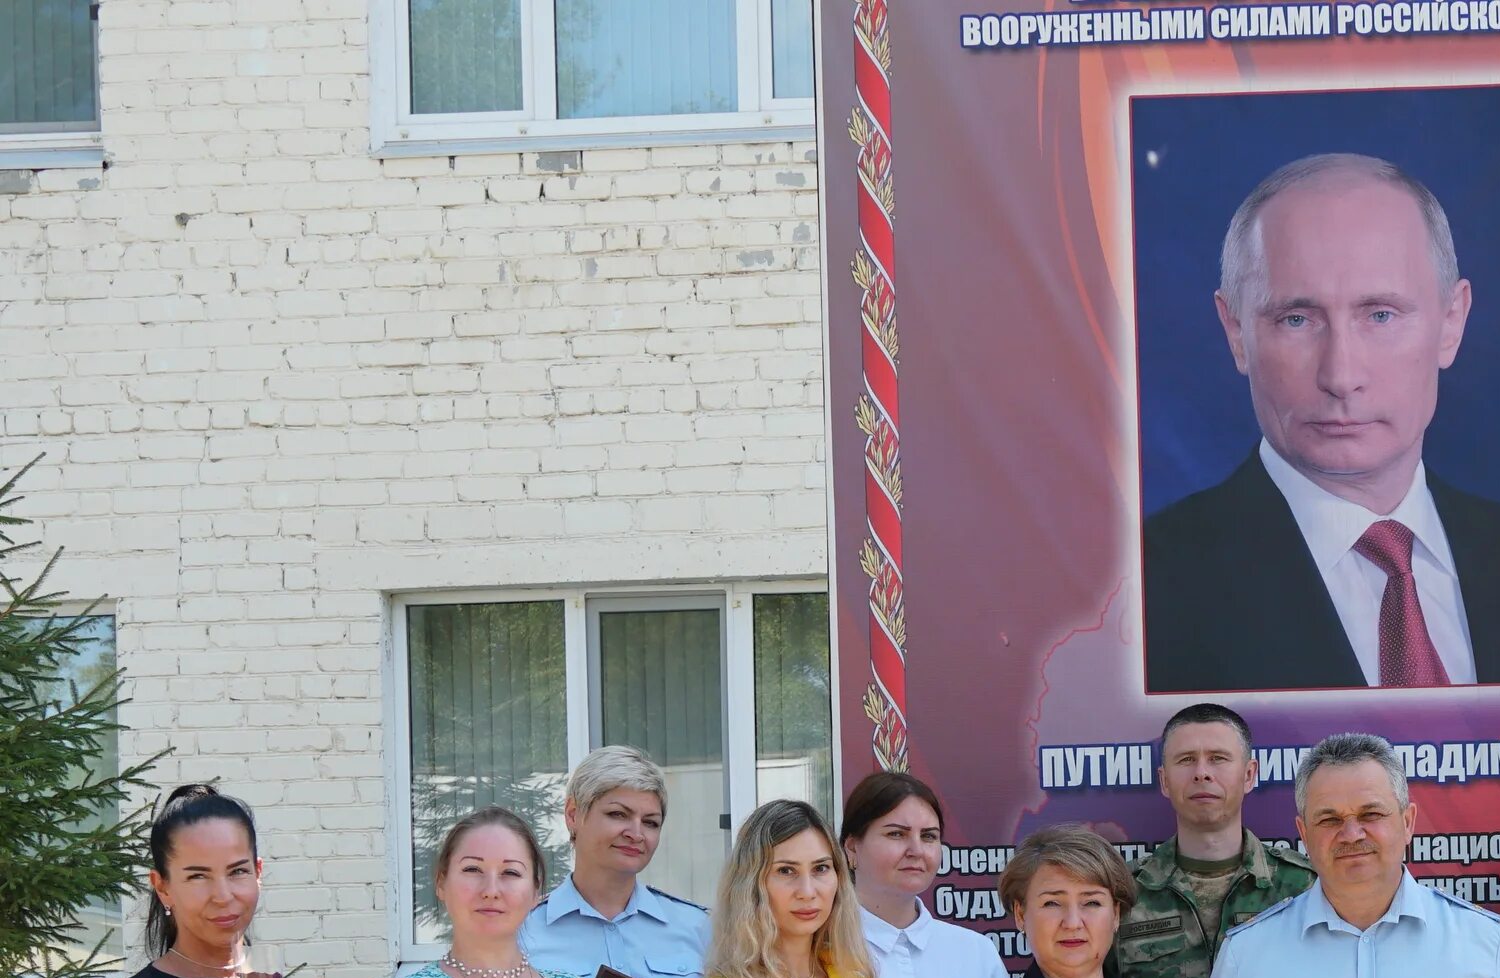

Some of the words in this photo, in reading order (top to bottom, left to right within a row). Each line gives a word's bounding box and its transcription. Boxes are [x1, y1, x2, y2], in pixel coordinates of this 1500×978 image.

[962, 9, 1204, 46] ВООРУЖЕННЫМИ
[1210, 5, 1330, 38] СИЛАМИ
[1041, 745, 1153, 788] ПУТИН
